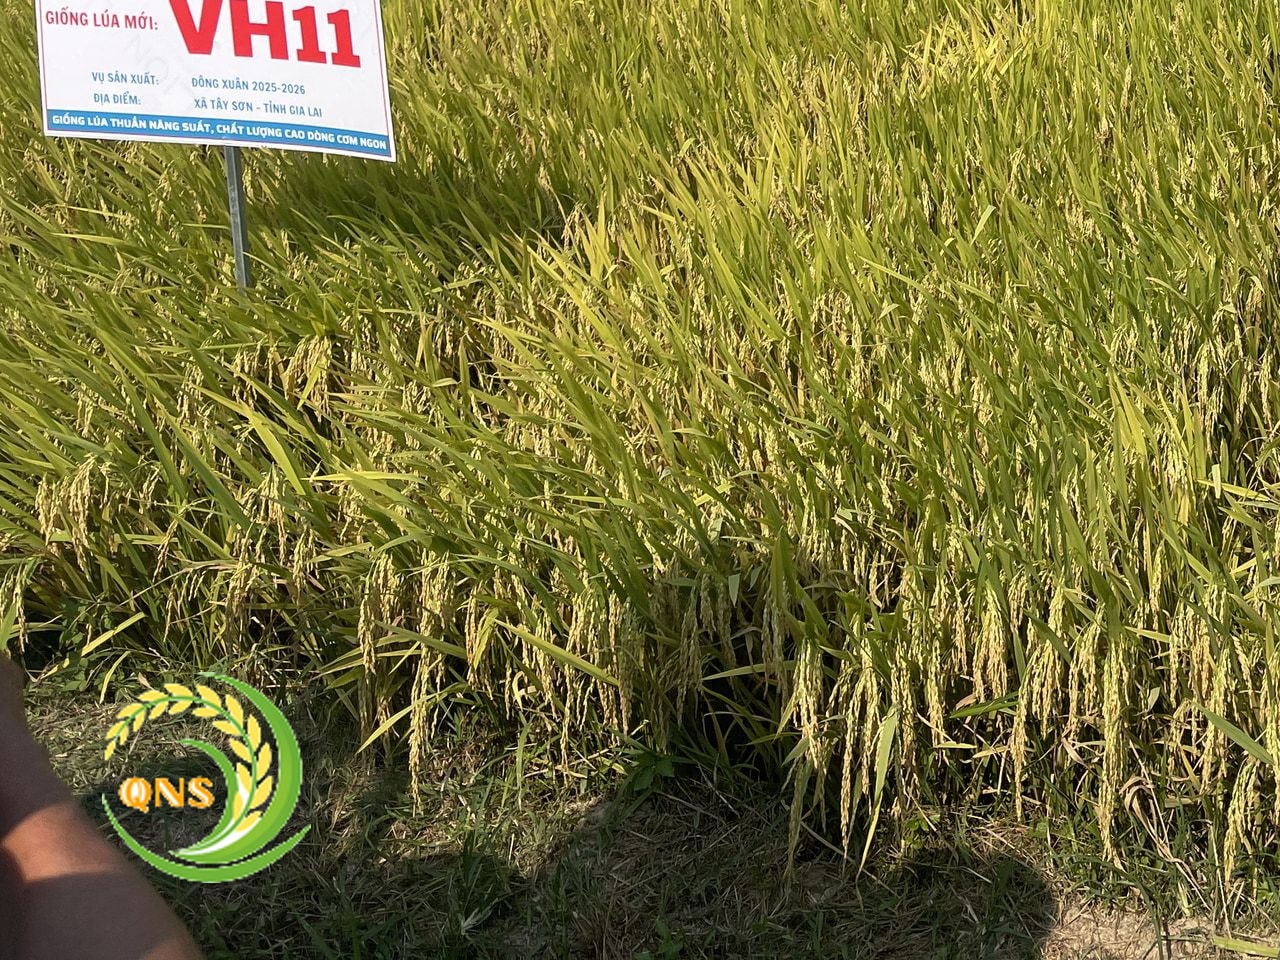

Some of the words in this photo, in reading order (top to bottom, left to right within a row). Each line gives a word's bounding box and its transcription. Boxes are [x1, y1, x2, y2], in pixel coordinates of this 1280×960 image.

[46, 6, 88, 26] GIỐNG
[93, 9, 120, 28] LÚA
[124, 11, 158, 30] MỚI:
[91, 72, 104, 83] VỤ
[107, 70, 128, 84] SẢN
[130, 71, 160, 86] XUẤT:
[192, 74, 219, 89] ĐÔNG
[222, 78, 249, 90] XUÂN
[252, 81, 306, 95] 2025-2026
[94, 93, 110, 106] ĐỊA
[113, 90, 142, 106] ĐIỂM:
[194, 96, 206, 110] XÃ
[211, 97, 229, 110] TÂY
[232, 100, 254, 112] SƠN
[263, 100, 286, 114] TỈNH
[290, 105, 306, 116] GIA
[308, 106, 322, 118] LAI
[52, 113, 85, 126] GIỐNG
[88, 114, 108, 126] LÚA
[182, 120, 214, 134] SUẤT,
[216, 122, 244, 134] CHẤT
[246, 125, 282, 138] LƯỢNG
[284, 128, 306, 140] CAO
[336, 134, 358, 146] CƠM
[360, 138, 387, 150] NGON
